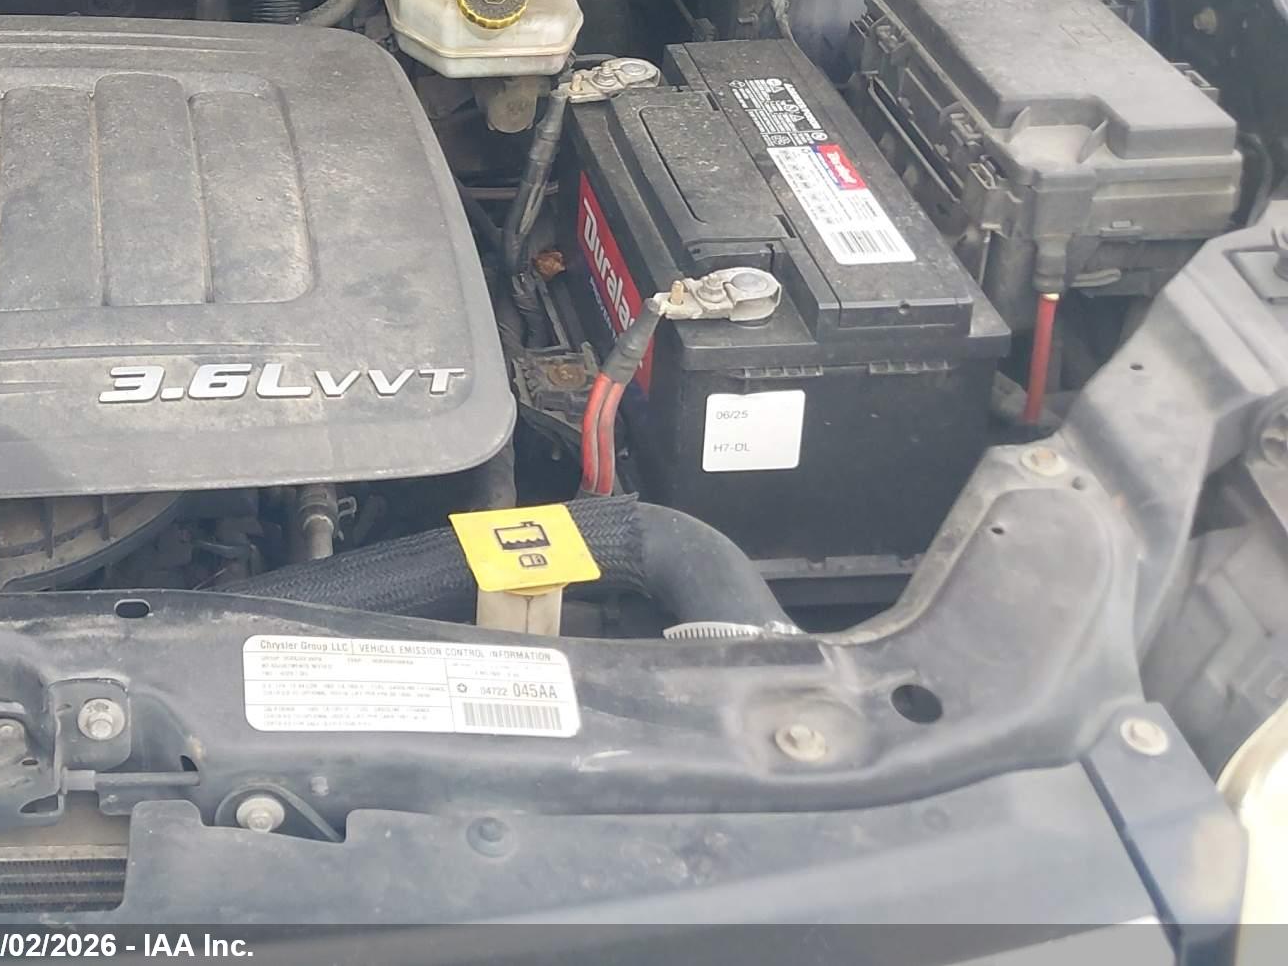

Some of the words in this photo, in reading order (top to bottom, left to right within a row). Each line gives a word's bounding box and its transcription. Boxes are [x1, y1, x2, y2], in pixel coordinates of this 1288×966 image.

[583, 197, 636, 332] Durala
[98, 362, 313, 404] 3.6L
[314, 367, 466, 398] VVT
[715, 410, 749, 420] 06/25
[259, 639, 298, 653] Chrysler
[300, 641, 329, 654] Group
[331, 642, 349, 653] LLC
[358, 642, 397, 655] VEHICLE
[399, 644, 443, 657] EMISSION
[445, 646, 486, 659] CONTROL
[489, 649, 552, 662] INFORMATION
[512, 683, 559, 700] 045AA
